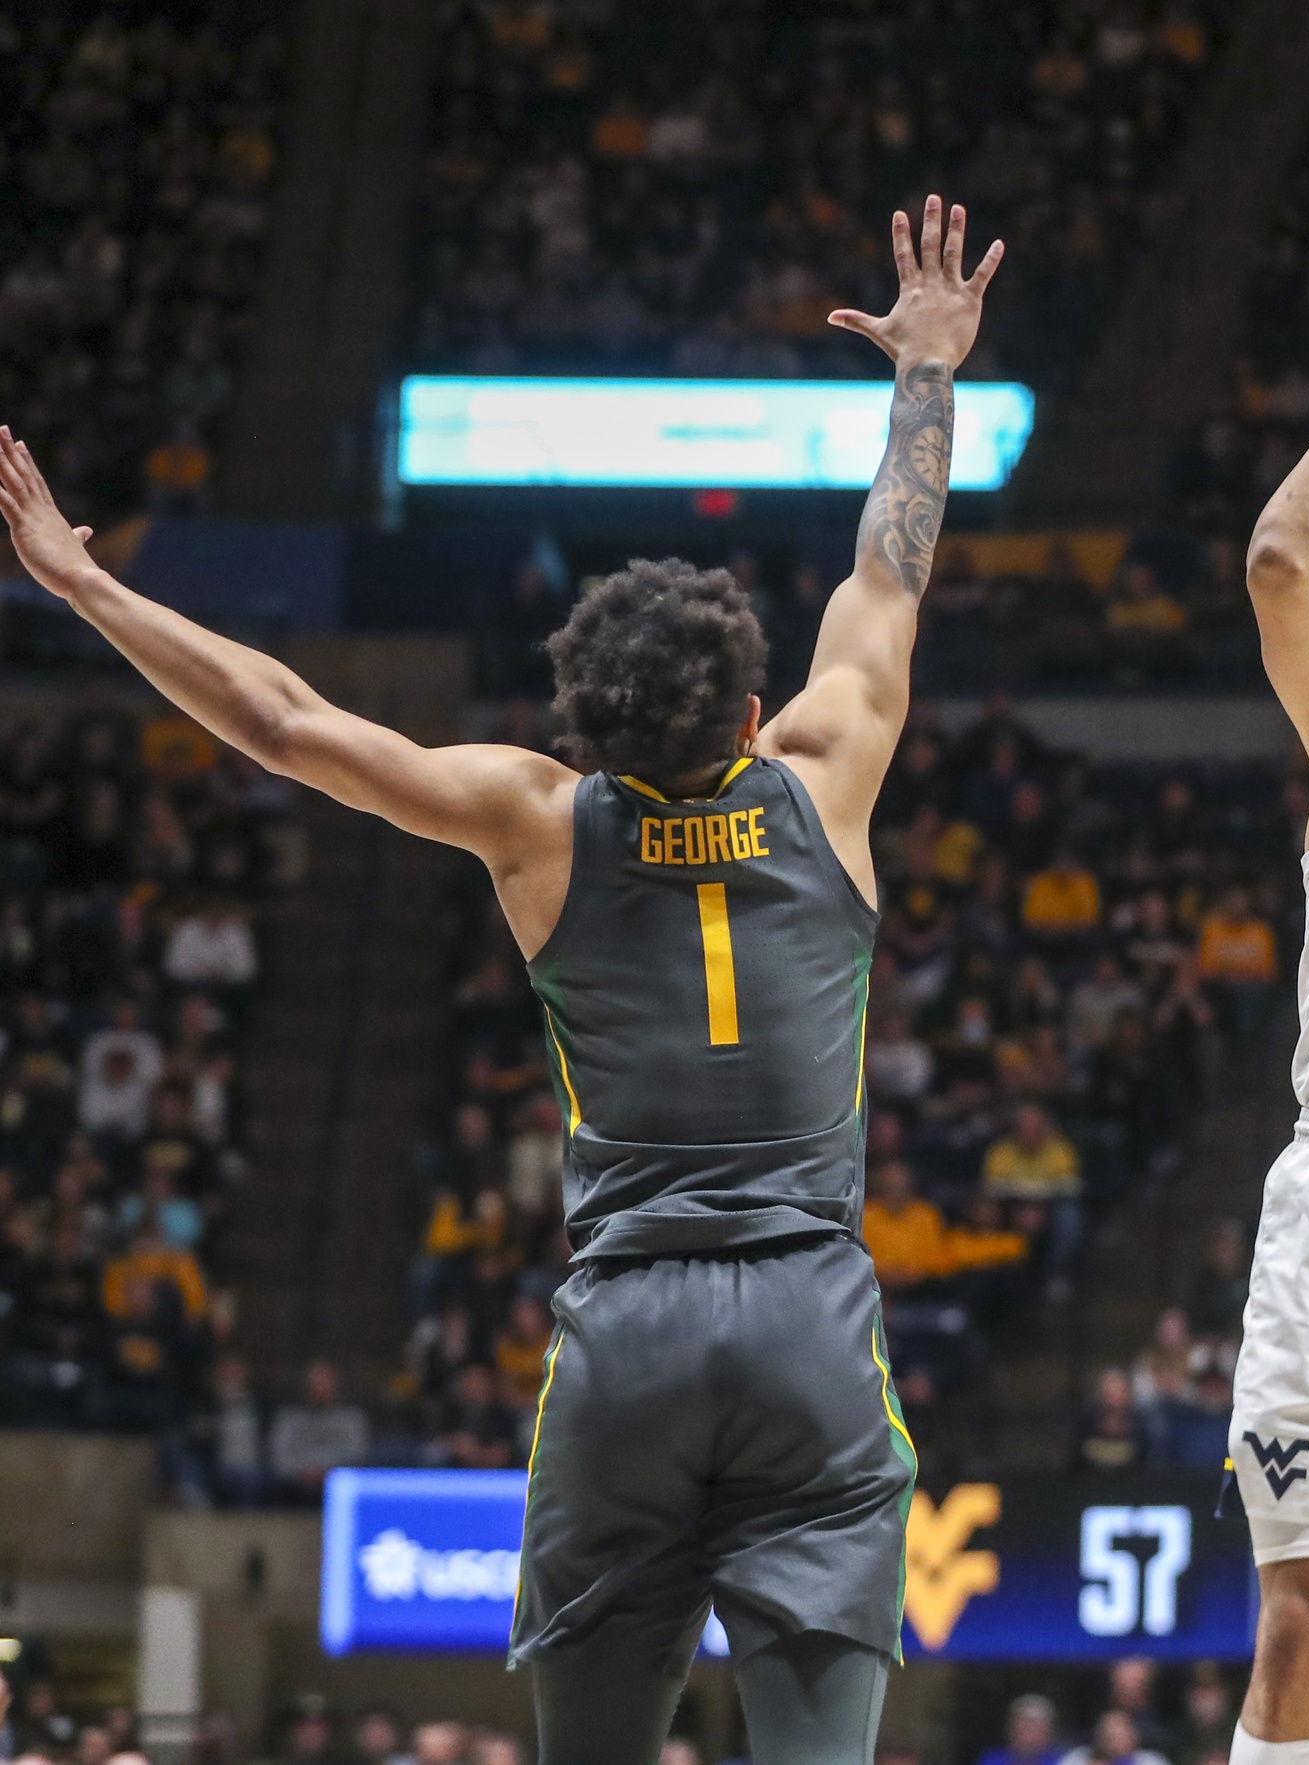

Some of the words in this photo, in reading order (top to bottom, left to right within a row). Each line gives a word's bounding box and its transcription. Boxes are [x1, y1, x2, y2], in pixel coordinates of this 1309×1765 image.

[641, 807, 770, 865] GEORGE
[696, 882, 739, 1046] 1
[1079, 1505, 1192, 1637] 57
